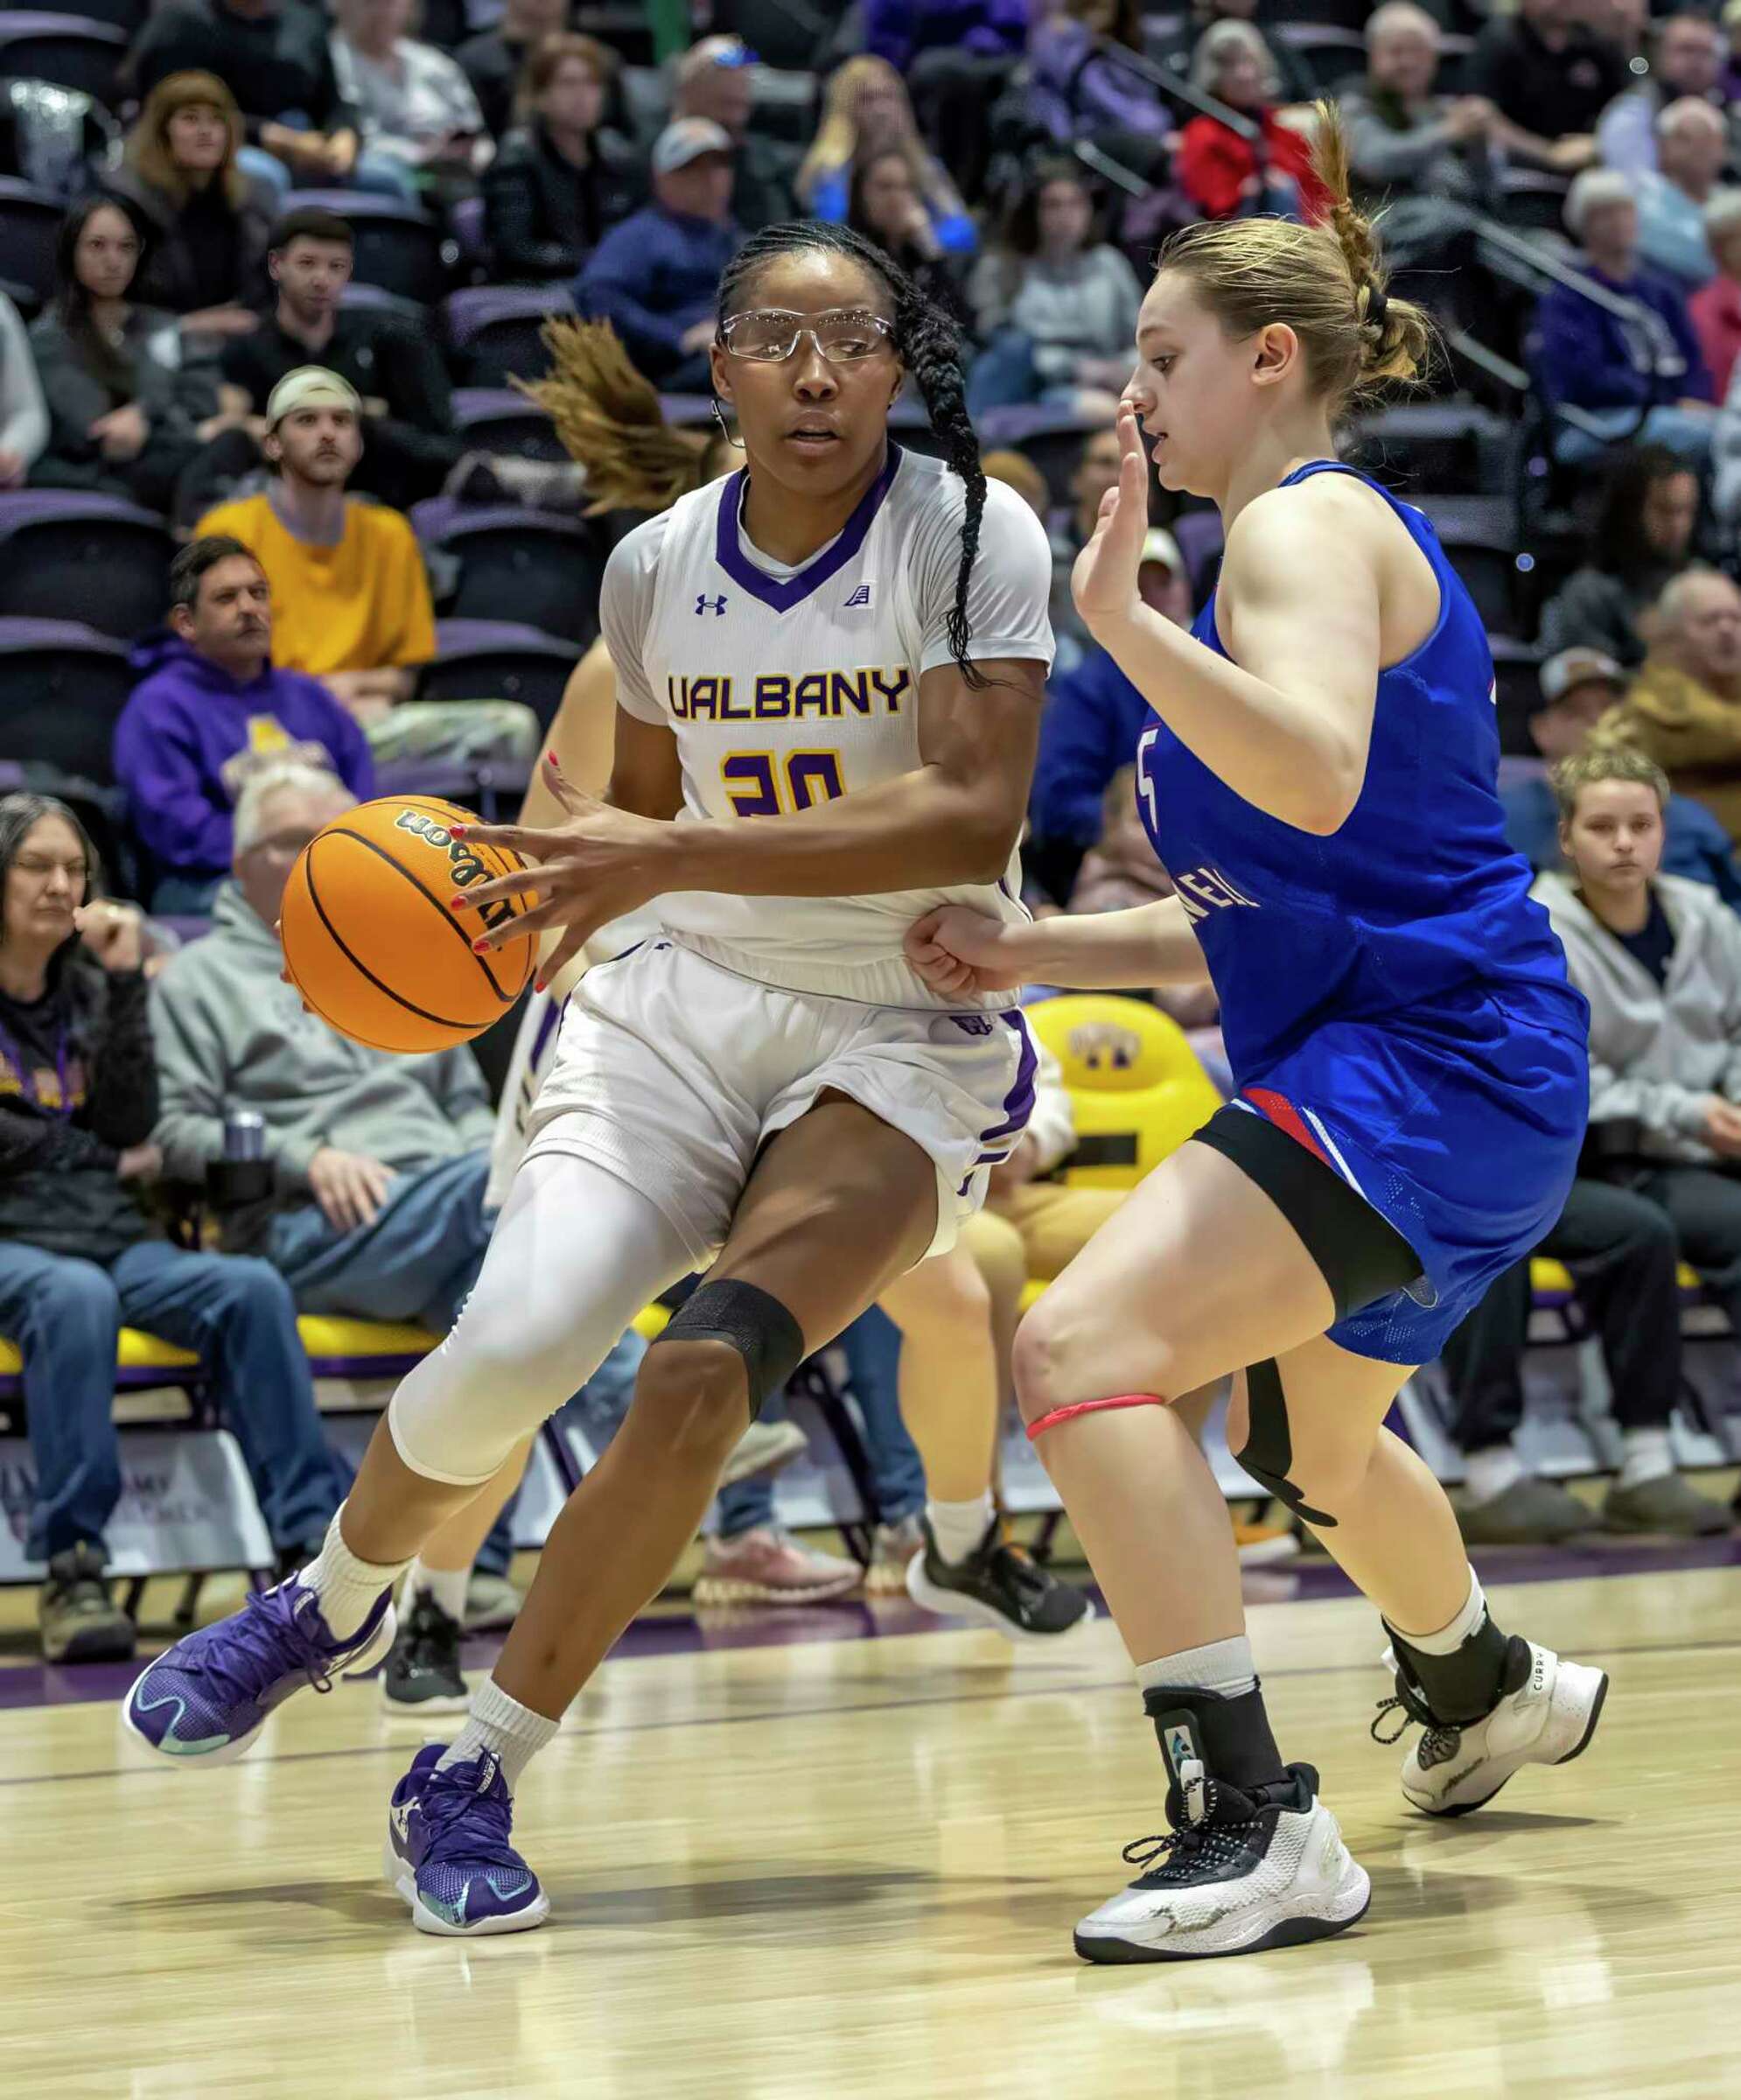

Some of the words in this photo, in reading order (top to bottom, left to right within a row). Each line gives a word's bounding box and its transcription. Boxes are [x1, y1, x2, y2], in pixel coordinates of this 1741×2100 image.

[667, 665, 912, 723] UALBANY
[719, 748, 847, 817] 20
[1534, 1652, 1545, 1691] CURRY
